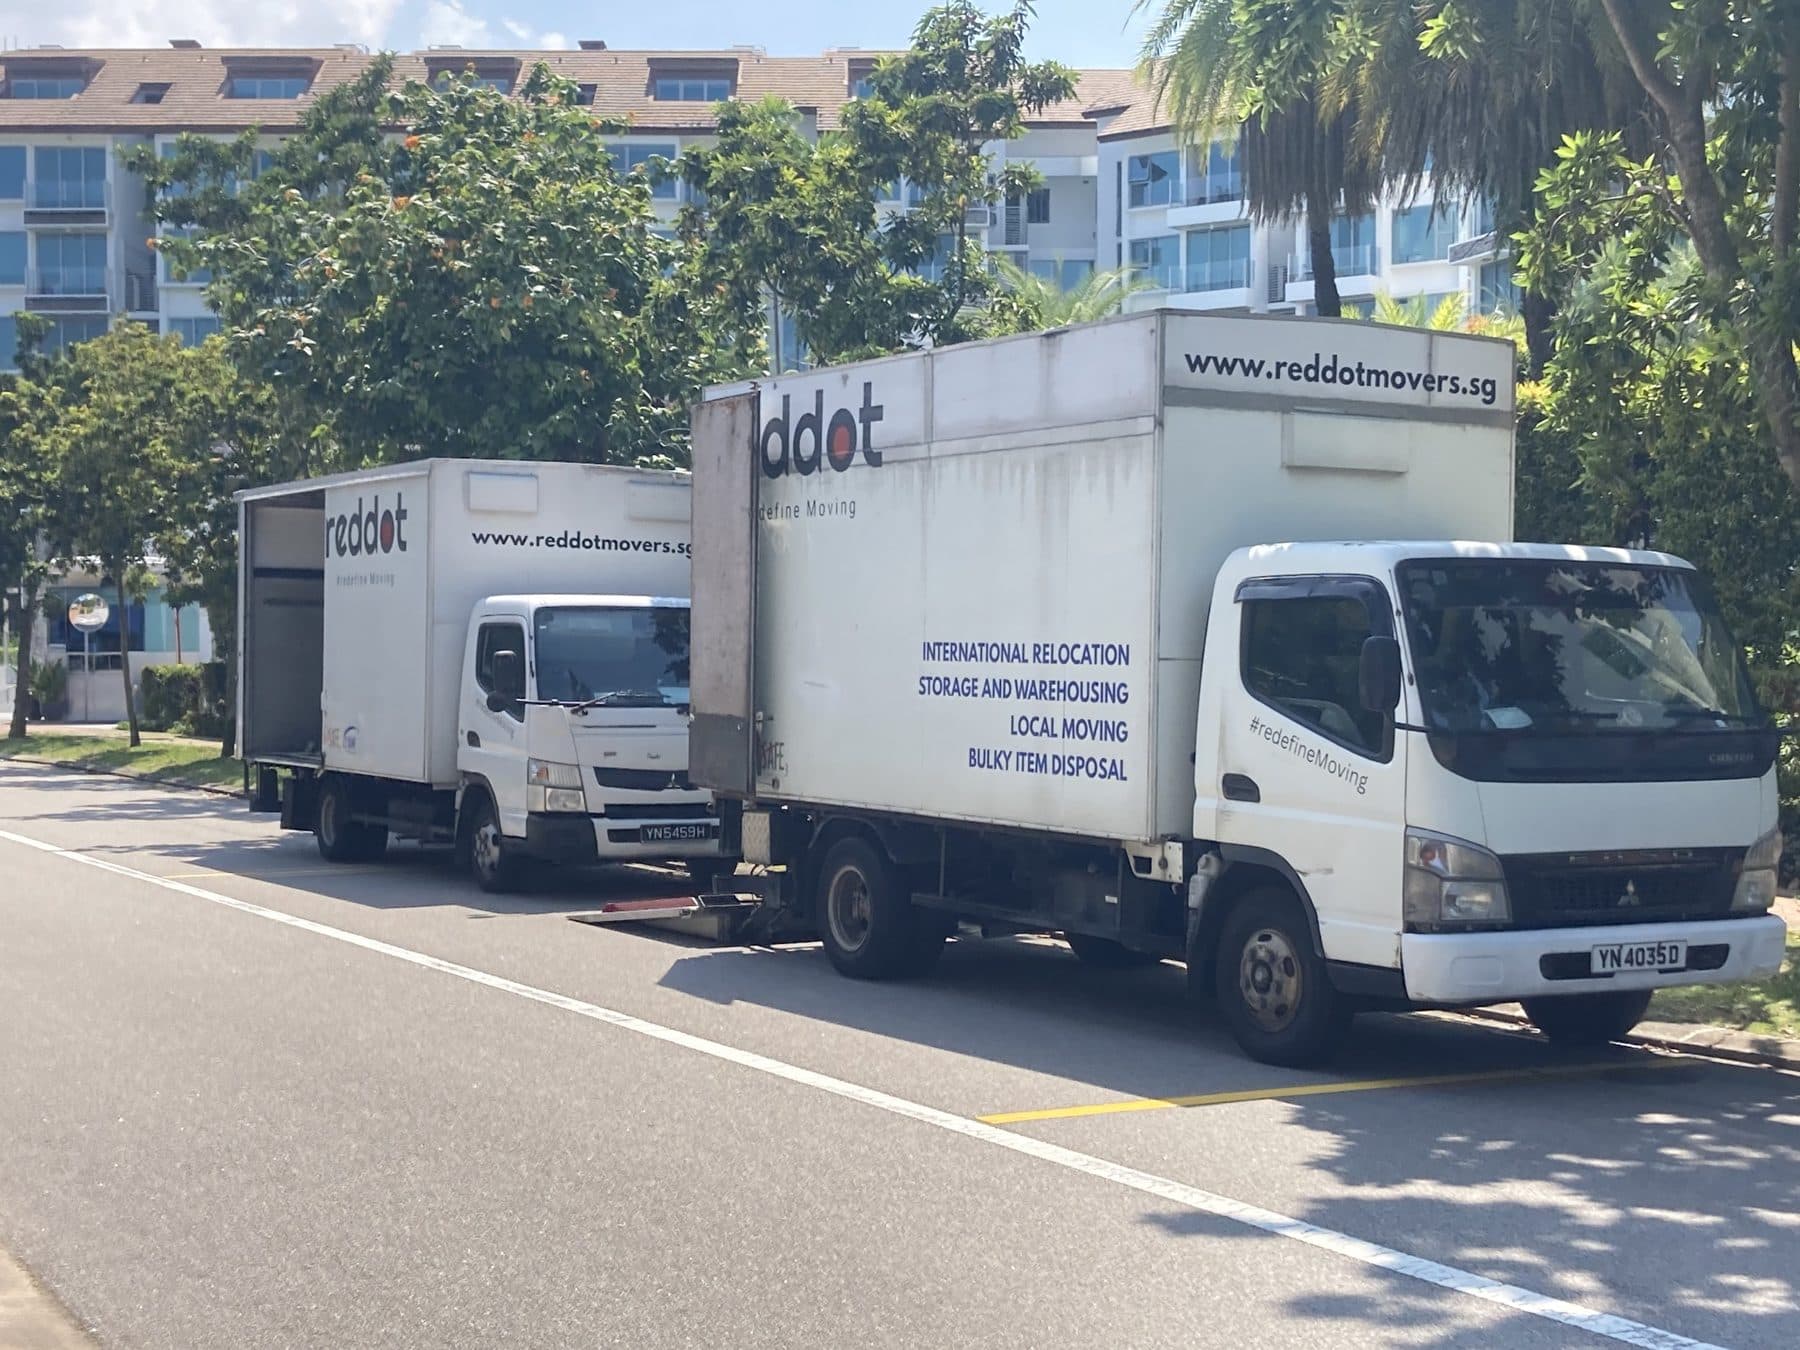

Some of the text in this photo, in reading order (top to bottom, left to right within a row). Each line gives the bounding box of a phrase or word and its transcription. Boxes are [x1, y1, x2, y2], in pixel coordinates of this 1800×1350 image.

[1185, 352, 1497, 405] www.reddotmovers.sg
[760, 381, 883, 479] ddot
[325, 492, 407, 558] reddot
[759, 499, 856, 521] define Moving
[922, 641, 1130, 666] INTERNATIONAL RELOCATION
[918, 676, 1129, 705] STORAGE AND WAREHOUSING
[1010, 715, 1128, 743] LOCAL MOVING
[968, 747, 1128, 781] BULKY ITEM DISPOSAL
[1249, 716, 1368, 795] #redefineMoving
[646, 823, 705, 840] YN5459H
